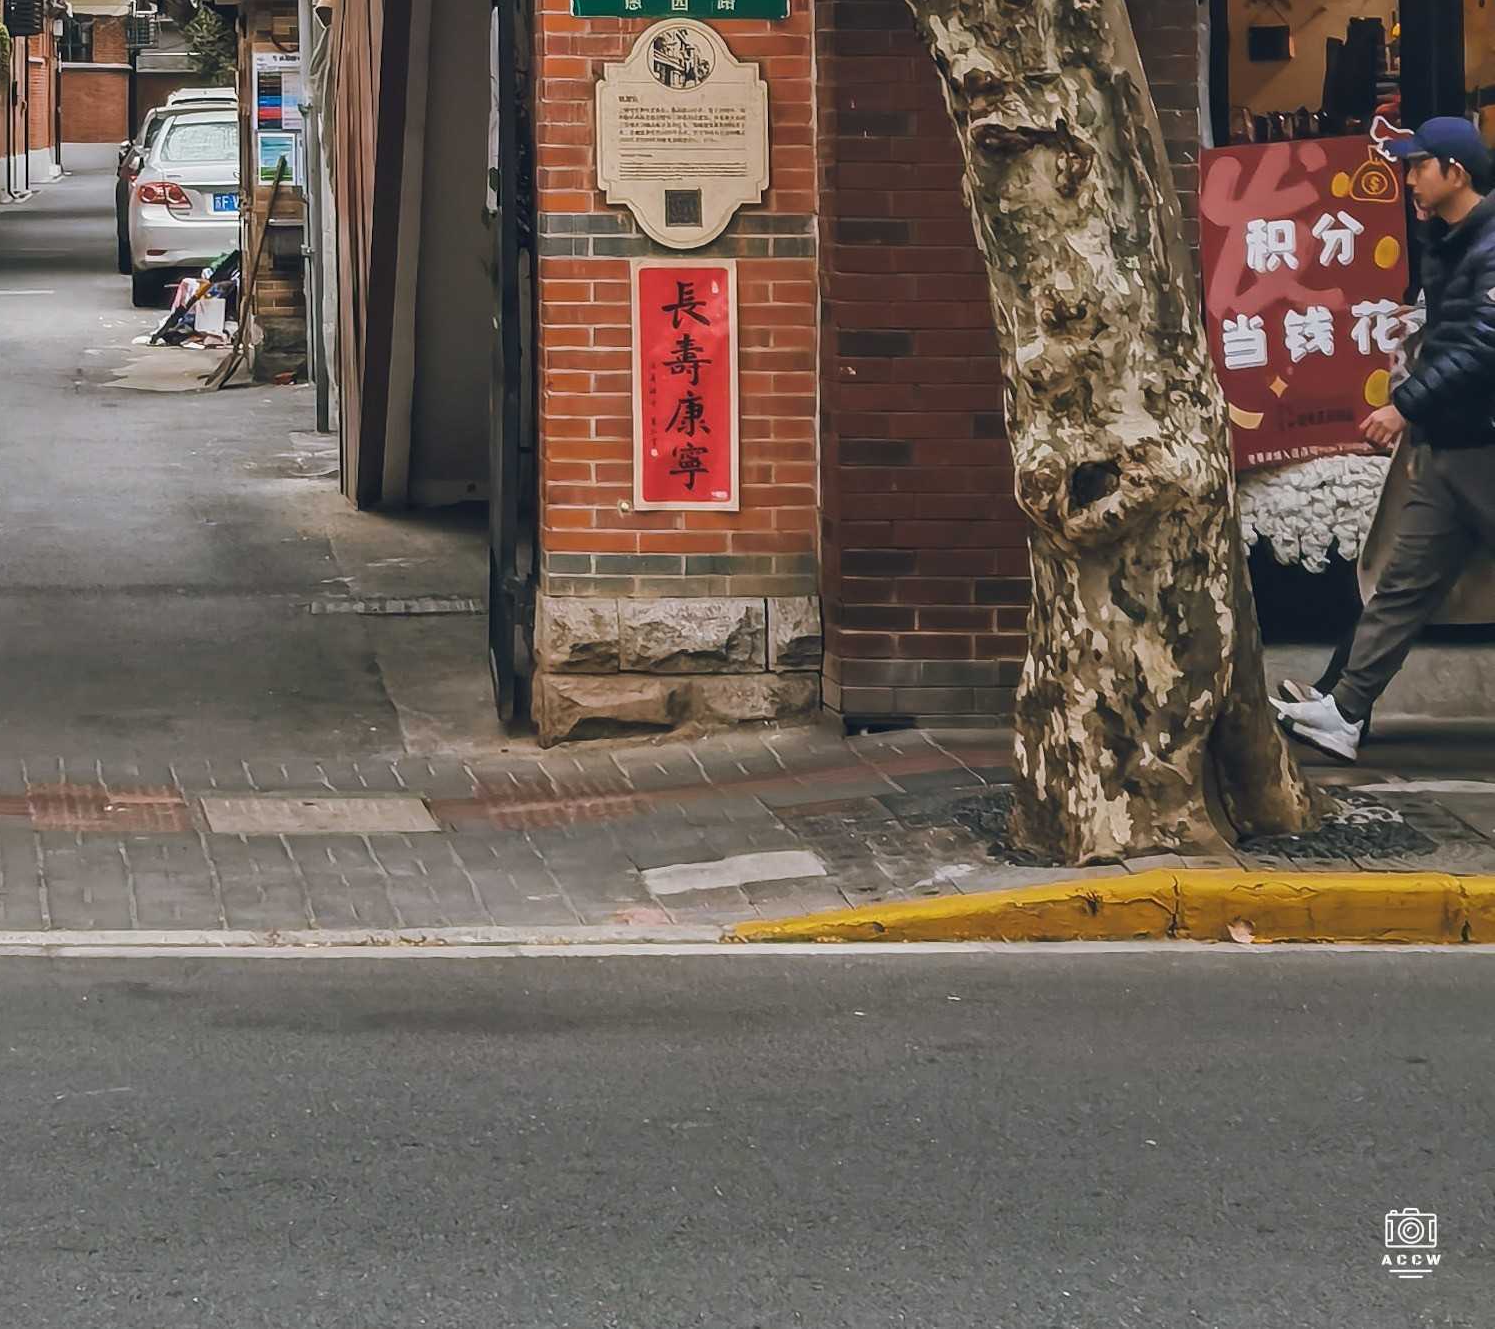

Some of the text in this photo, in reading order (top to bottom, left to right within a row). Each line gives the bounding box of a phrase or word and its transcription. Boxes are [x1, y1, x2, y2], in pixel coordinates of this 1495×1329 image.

[1245, 210, 1365, 274] 积分
[1222, 298, 1409, 370] 当钱花
